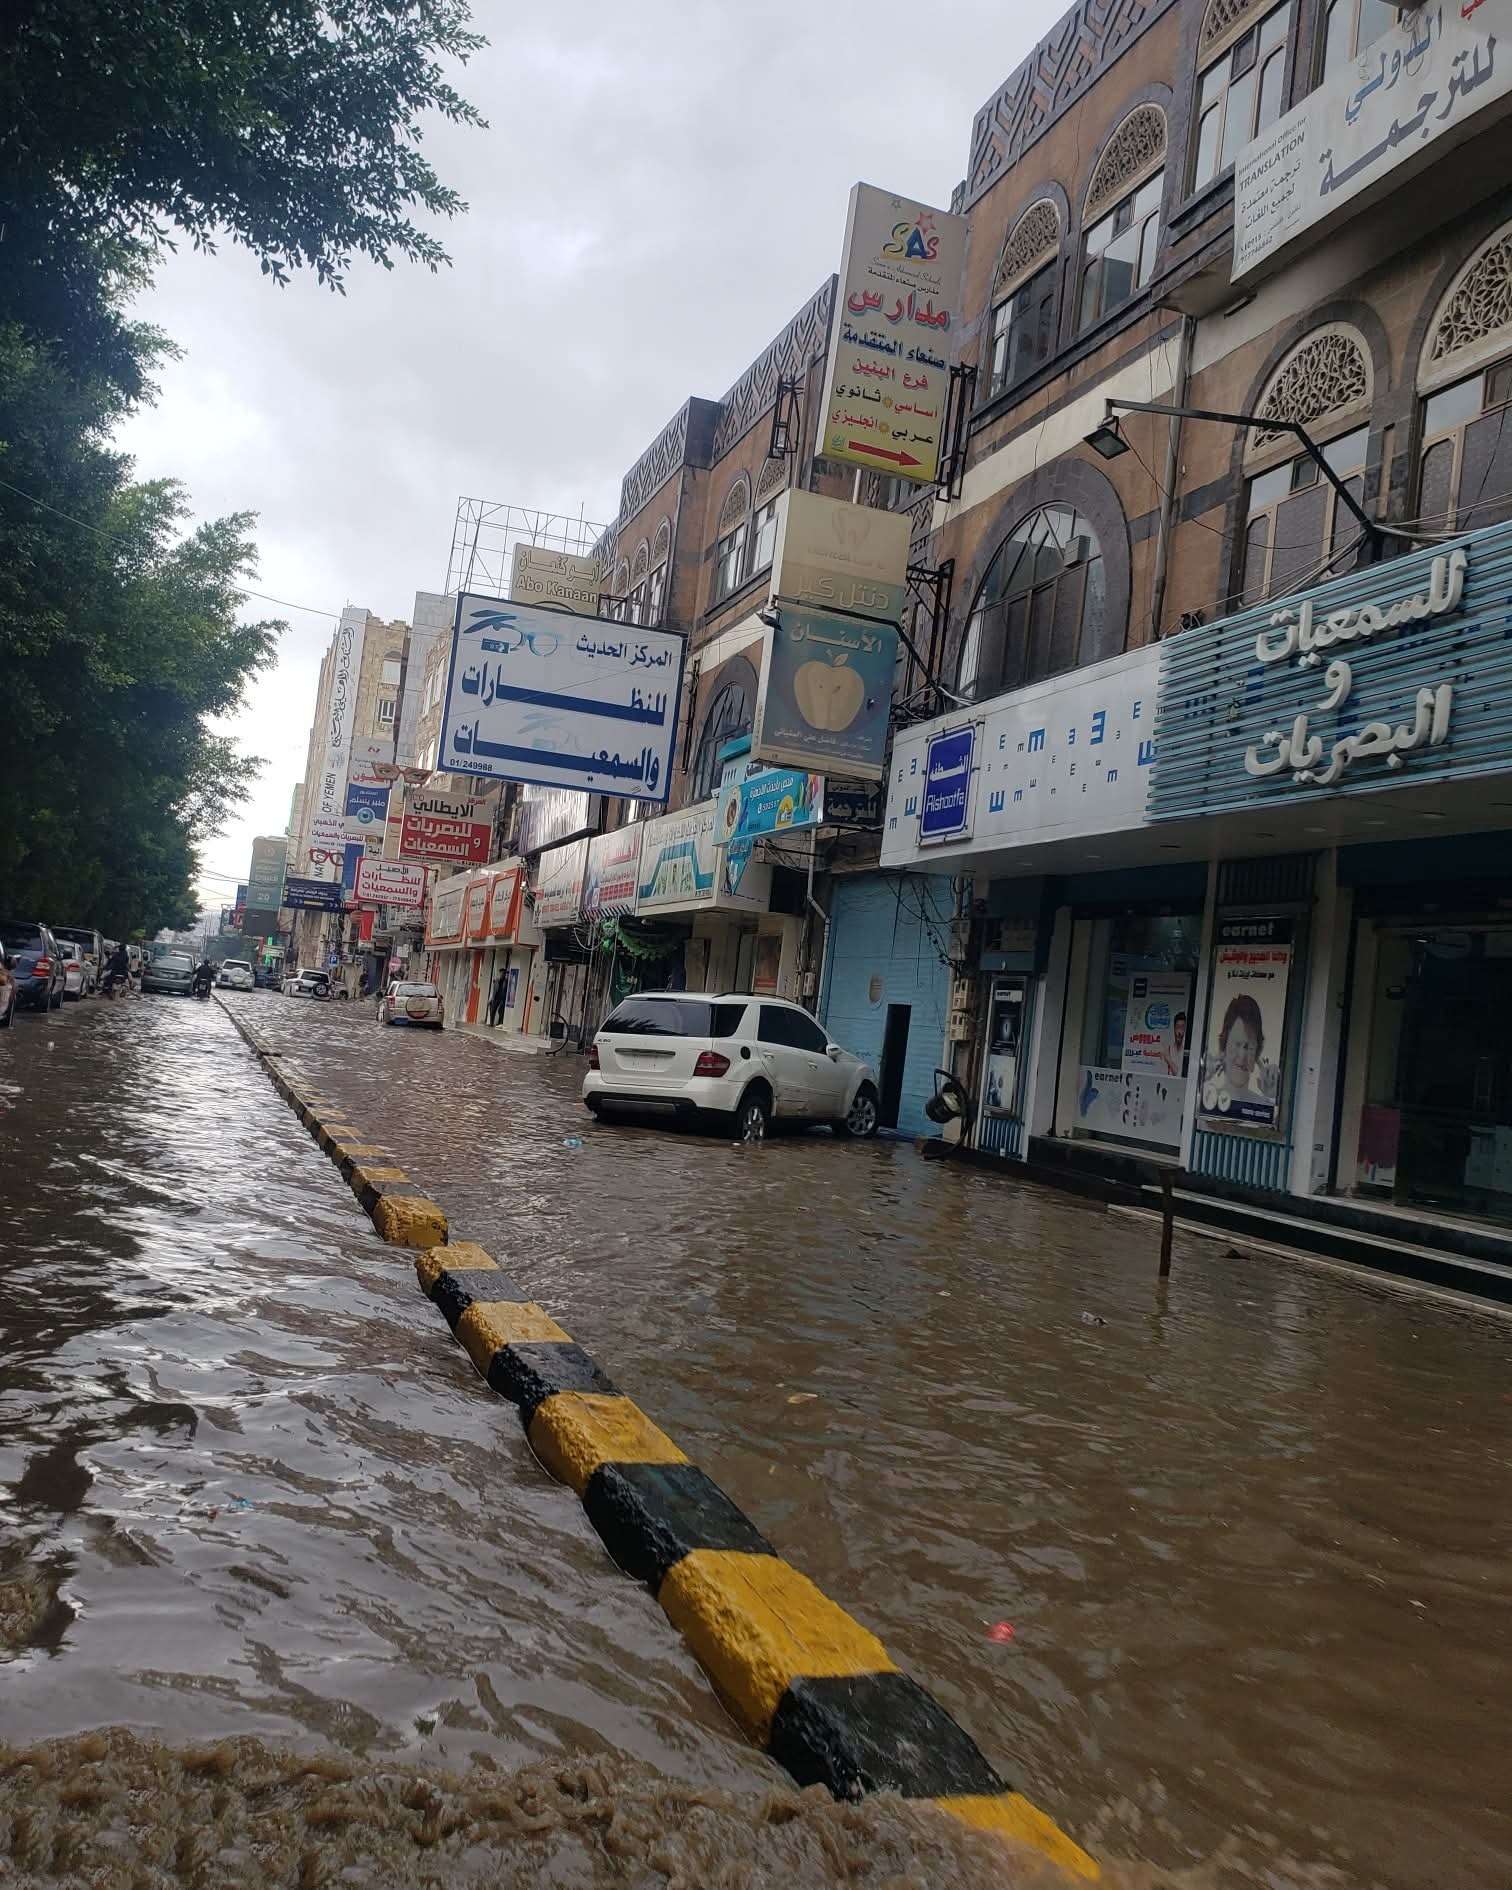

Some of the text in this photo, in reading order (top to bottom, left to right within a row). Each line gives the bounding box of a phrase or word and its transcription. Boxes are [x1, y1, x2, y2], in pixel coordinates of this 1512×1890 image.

[1319, 33, 1497, 197] للترجمة
[1239, 131, 1305, 192] TRANSLATION
[848, 289, 950, 329] مدارس
[842, 323, 946, 371] صنعاء المتقدمة
[835, 384, 881, 402] ثانوي
[903, 374, 929, 391] فرع
[891, 429, 935, 444] عربي
[515, 575, 598, 604] Abo Kanaan
[839, 584, 889, 611] دنتل
[1256, 548, 1469, 668] للسمعيات
[575, 634, 672, 668] المركز الحديث
[461, 660, 668, 727] للنظارات
[1318, 660, 1353, 710] و
[1245, 682, 1454, 785] البصريات
[449, 758, 494, 773] 01/249988
[453, 719, 661, 792] والسمعيات
[324, 773, 336, 801] YEMEN
[322, 802, 333, 813] OF
[413, 799, 475, 819] الايطالي
[406, 817, 473, 840] للبصريات
[404, 837, 481, 857] و السمعيات
[362, 871, 421, 886] للنظارات
[362, 881, 418, 898] والسمعيات
